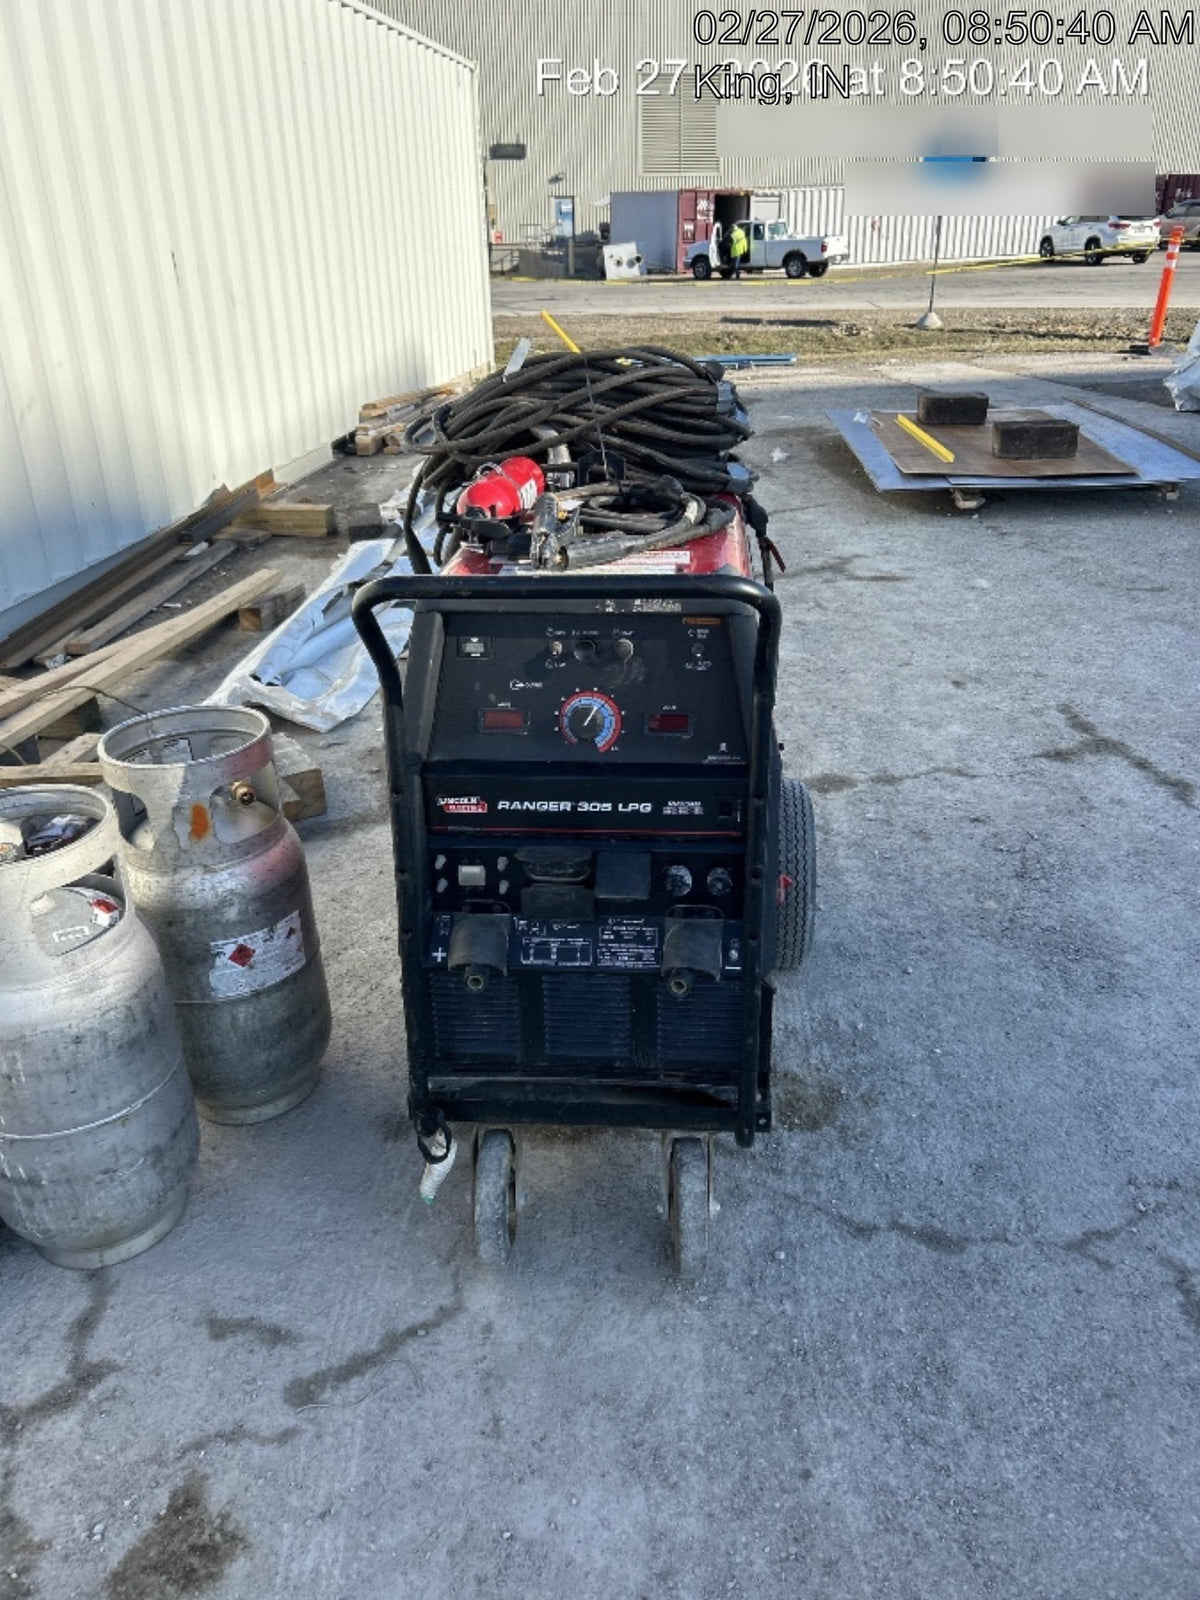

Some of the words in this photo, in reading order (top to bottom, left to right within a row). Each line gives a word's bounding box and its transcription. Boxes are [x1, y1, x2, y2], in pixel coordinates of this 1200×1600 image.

[497, 801, 571, 812] RANGER
[577, 802, 612, 812] 305
[618, 802, 652, 813] LPG
